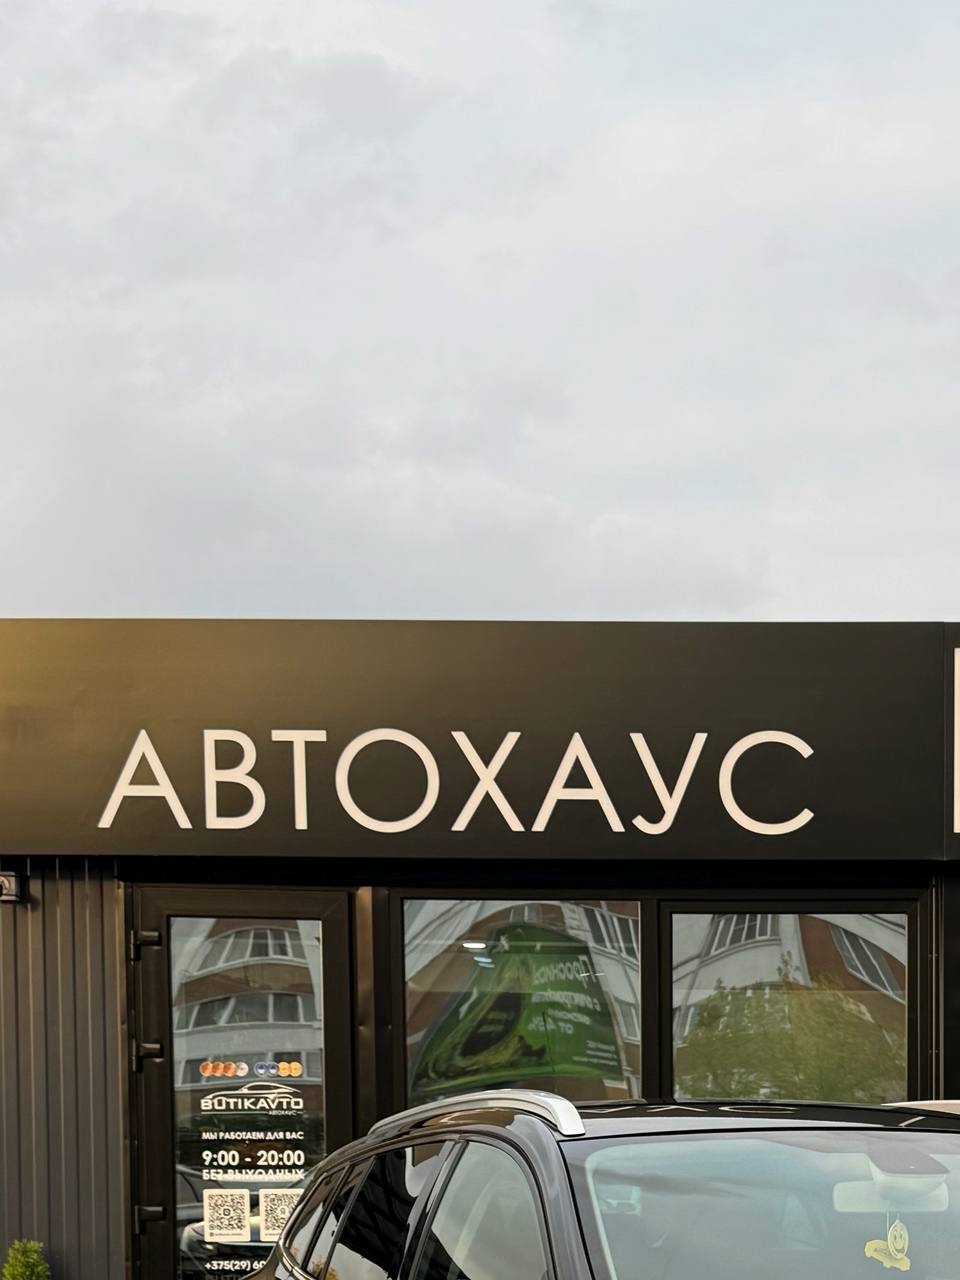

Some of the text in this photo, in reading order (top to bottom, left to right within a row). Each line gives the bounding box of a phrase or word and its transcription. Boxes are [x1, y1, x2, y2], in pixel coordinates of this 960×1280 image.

[97, 728, 815, 835] АВТОХАУС
[200, 1098, 304, 1110] BUTIKAVTO
[202, 1131, 305, 1140] МЫ РАБОТАЕМ ДЛЯ ВАС
[202, 1150, 239, 1166] 9:00
[256, 1150, 305, 1166] 20:00
[202, 1168, 224, 1180] БЕЗ
[204, 1260, 250, 1271] +375(29)
